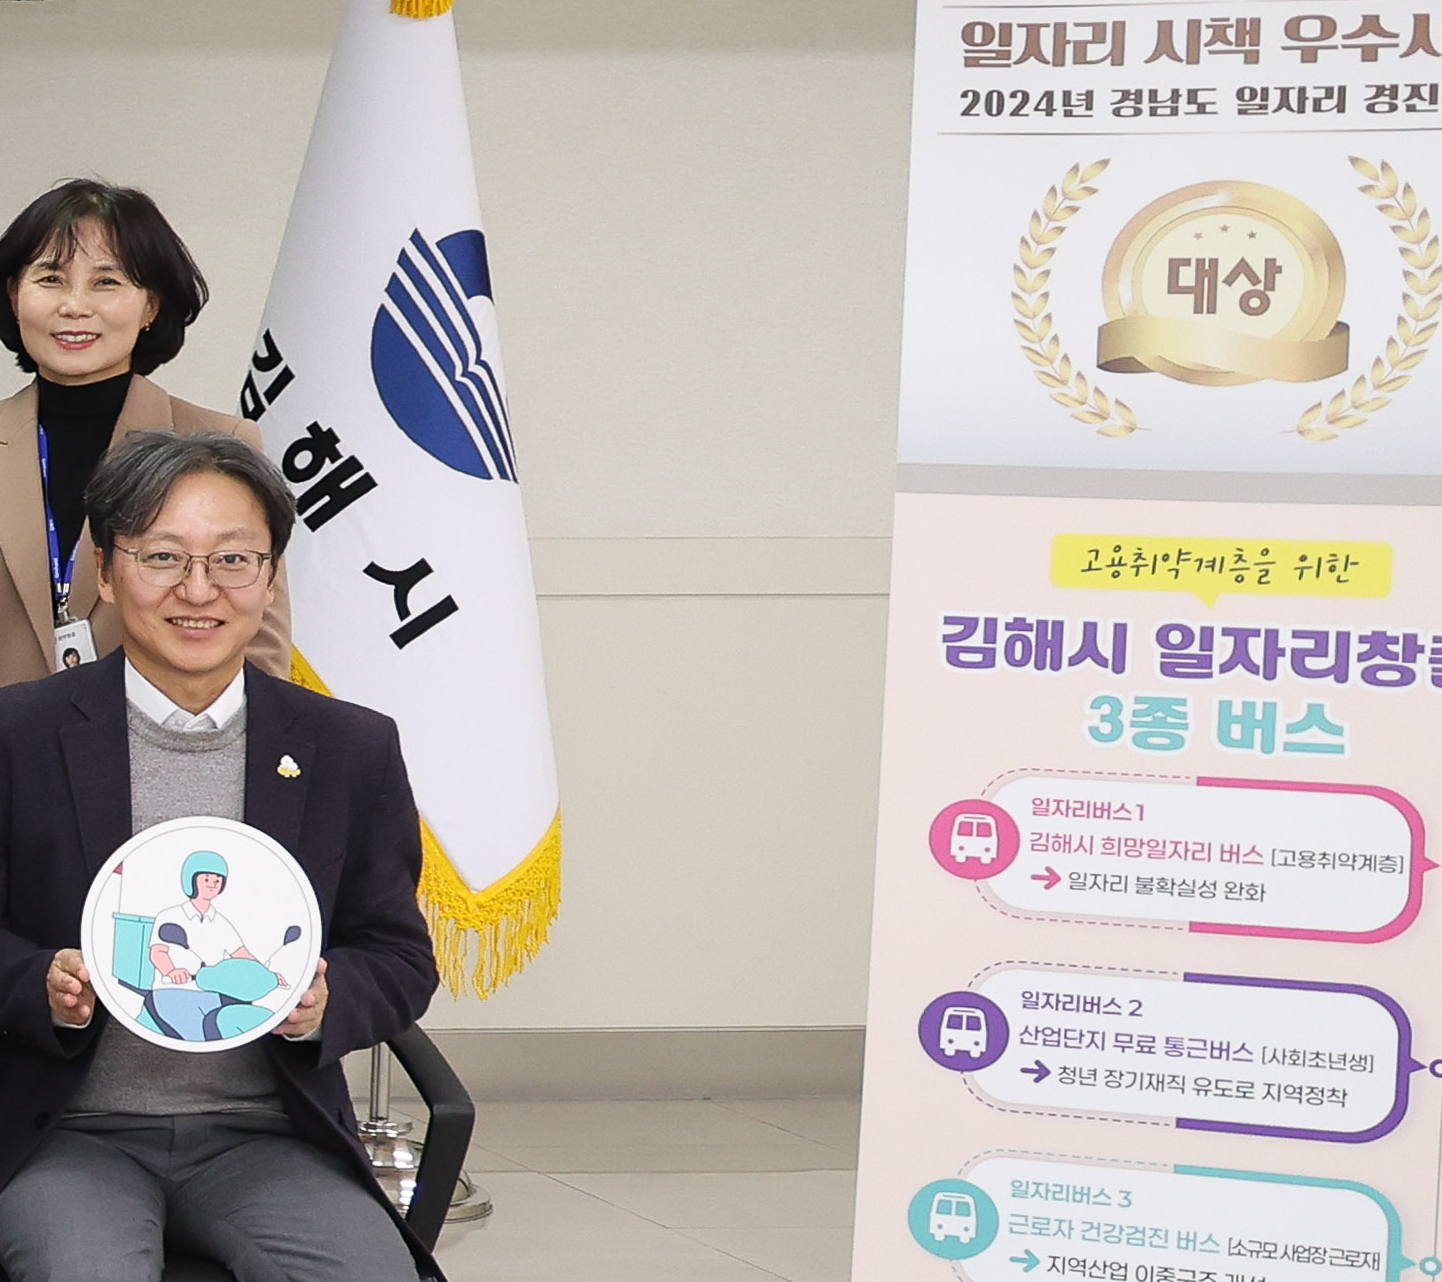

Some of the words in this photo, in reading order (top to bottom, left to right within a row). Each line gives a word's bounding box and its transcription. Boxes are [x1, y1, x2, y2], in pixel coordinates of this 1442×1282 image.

[961, 20, 1126, 68] 일자리
[1143, 17, 1261, 65] 시책
[960, 89, 1094, 118] 2024년
[1110, 87, 1219, 117] 경남도
[1235, 84, 1347, 115] 일자리
[1363, 82, 1439, 114] 경진
[1167, 256, 1282, 316] 대상
[1080, 544, 1277, 585] 고용취약계층을
[1293, 553, 1360, 584] 위한
[941, 615, 1129, 675] 김해시
[1088, 694, 1190, 751] 3종
[1216, 699, 1347, 755] 버스
[1029, 832, 1094, 856] 김해시
[1100, 836, 1213, 863] 희망일자리
[1219, 843, 1264, 866] 버스
[1271, 847, 1404, 875] [고용취약계층]
[1068, 871, 1129, 894] 일자리
[1134, 875, 1218, 900] 불확실성
[1223, 880, 1267, 903] 완화
[1021, 990, 1123, 1016] 일자리버스
[1128, 999, 1144, 1018] 2
[1018, 1024, 1107, 1052] 산업단지
[1112, 1032, 1157, 1056] 무료
[1163, 1035, 1255, 1063] 통근버스
[1261, 1045, 1375, 1074] [사회초년생]
[1057, 1065, 1098, 1088] 청년
[1103, 1069, 1187, 1095] 장기재직
[1192, 1076, 1256, 1101] 유도로
[1261, 1082, 1349, 1109] 지역정착
[1010, 1179, 1112, 1207] 일자리버스
[1117, 1189, 1133, 1209] 3
[1008, 1213, 1075, 1240] 근로자
[1080, 1220, 1170, 1249] 건강검진
[1176, 1229, 1221, 1255] 버스
[1046, 1254, 1129, 1282] 지역산업
